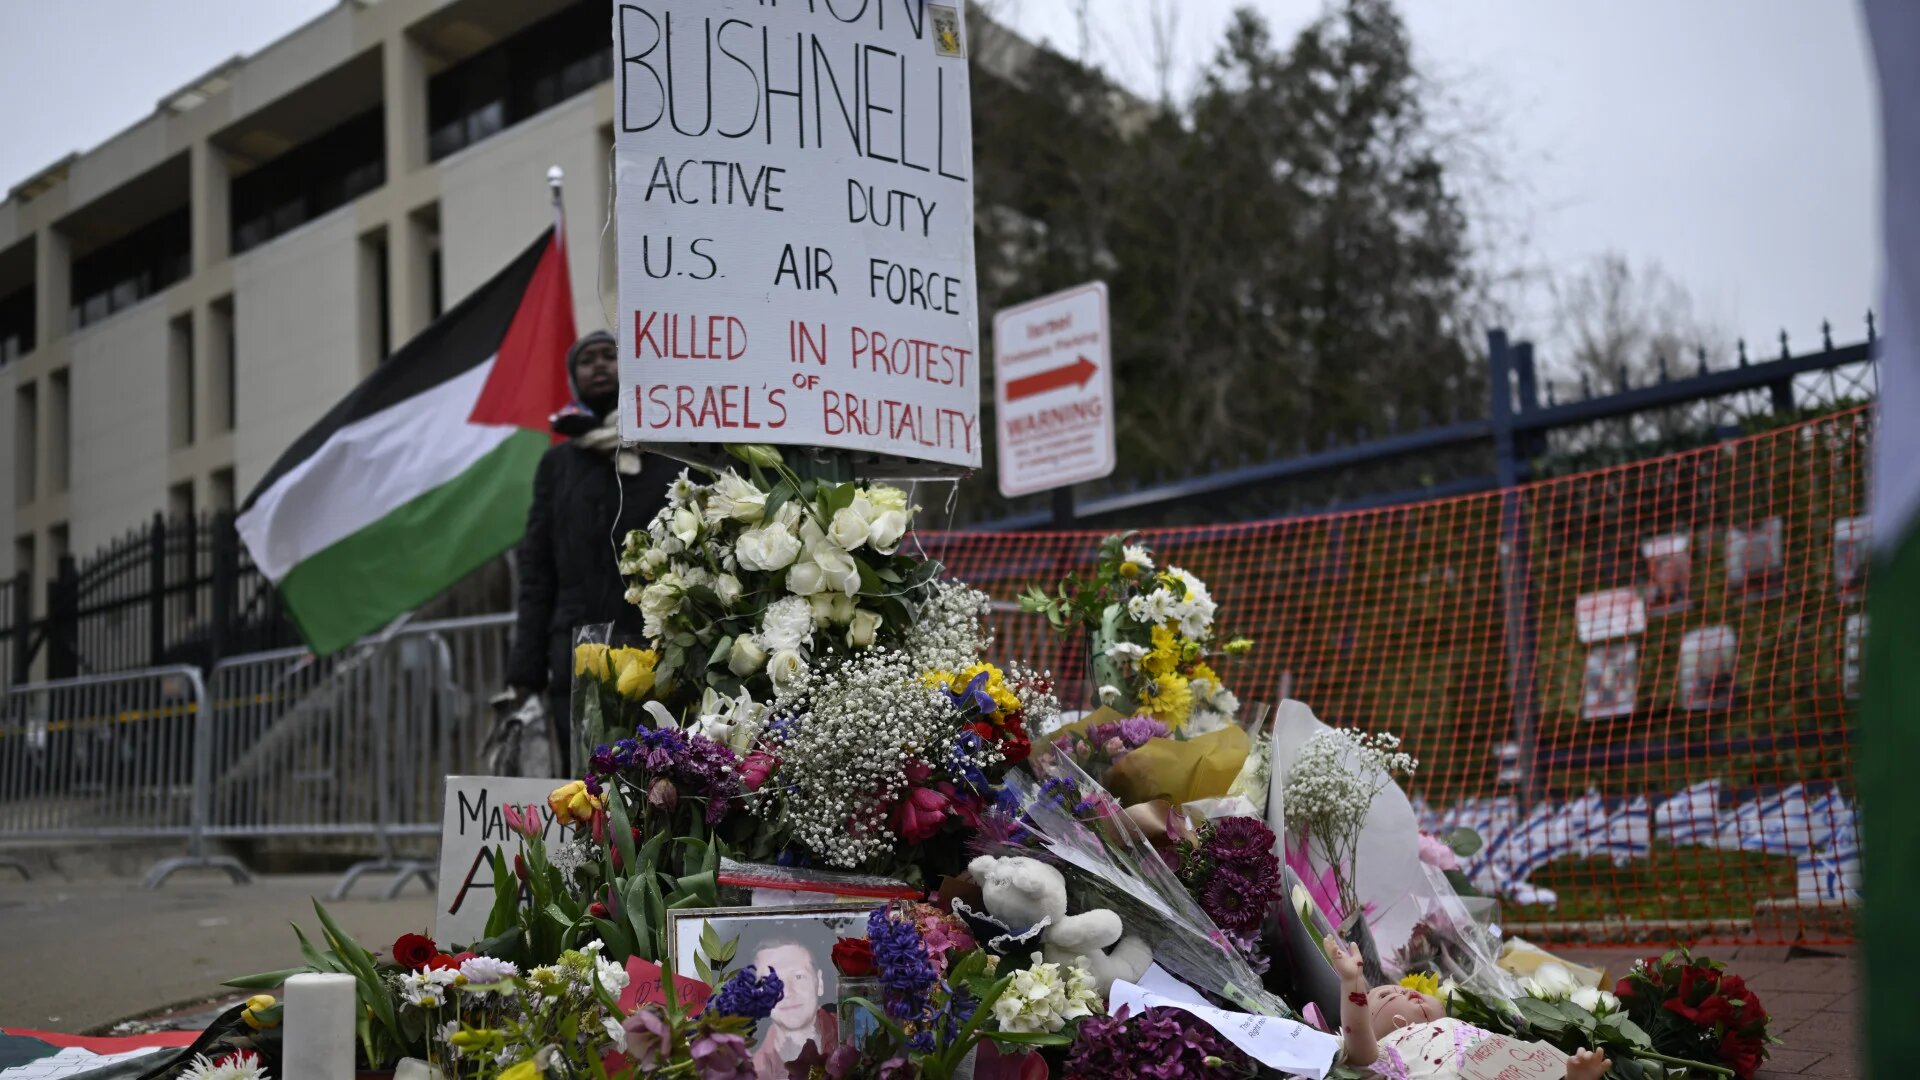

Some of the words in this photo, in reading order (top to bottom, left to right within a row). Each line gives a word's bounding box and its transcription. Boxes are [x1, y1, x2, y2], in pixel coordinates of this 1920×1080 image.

[619, 4, 968, 183] BUSHNELL
[644, 156, 787, 212] ACTIVE
[848, 178, 936, 237] DUTY
[643, 234, 726, 281] U.S.
[773, 243, 838, 296] AIR
[869, 258, 962, 316] FORCE
[634, 310, 748, 361] KILLED
[789, 320, 827, 366] IN
[851, 326, 972, 388] PROTEST
[792, 372, 821, 390] OF
[635, 381, 787, 430] ISRAEL'S
[822, 390, 975, 454] BRUTALITY
[1006, 397, 1102, 436] WARNING
[458, 789, 566, 843] MARY
